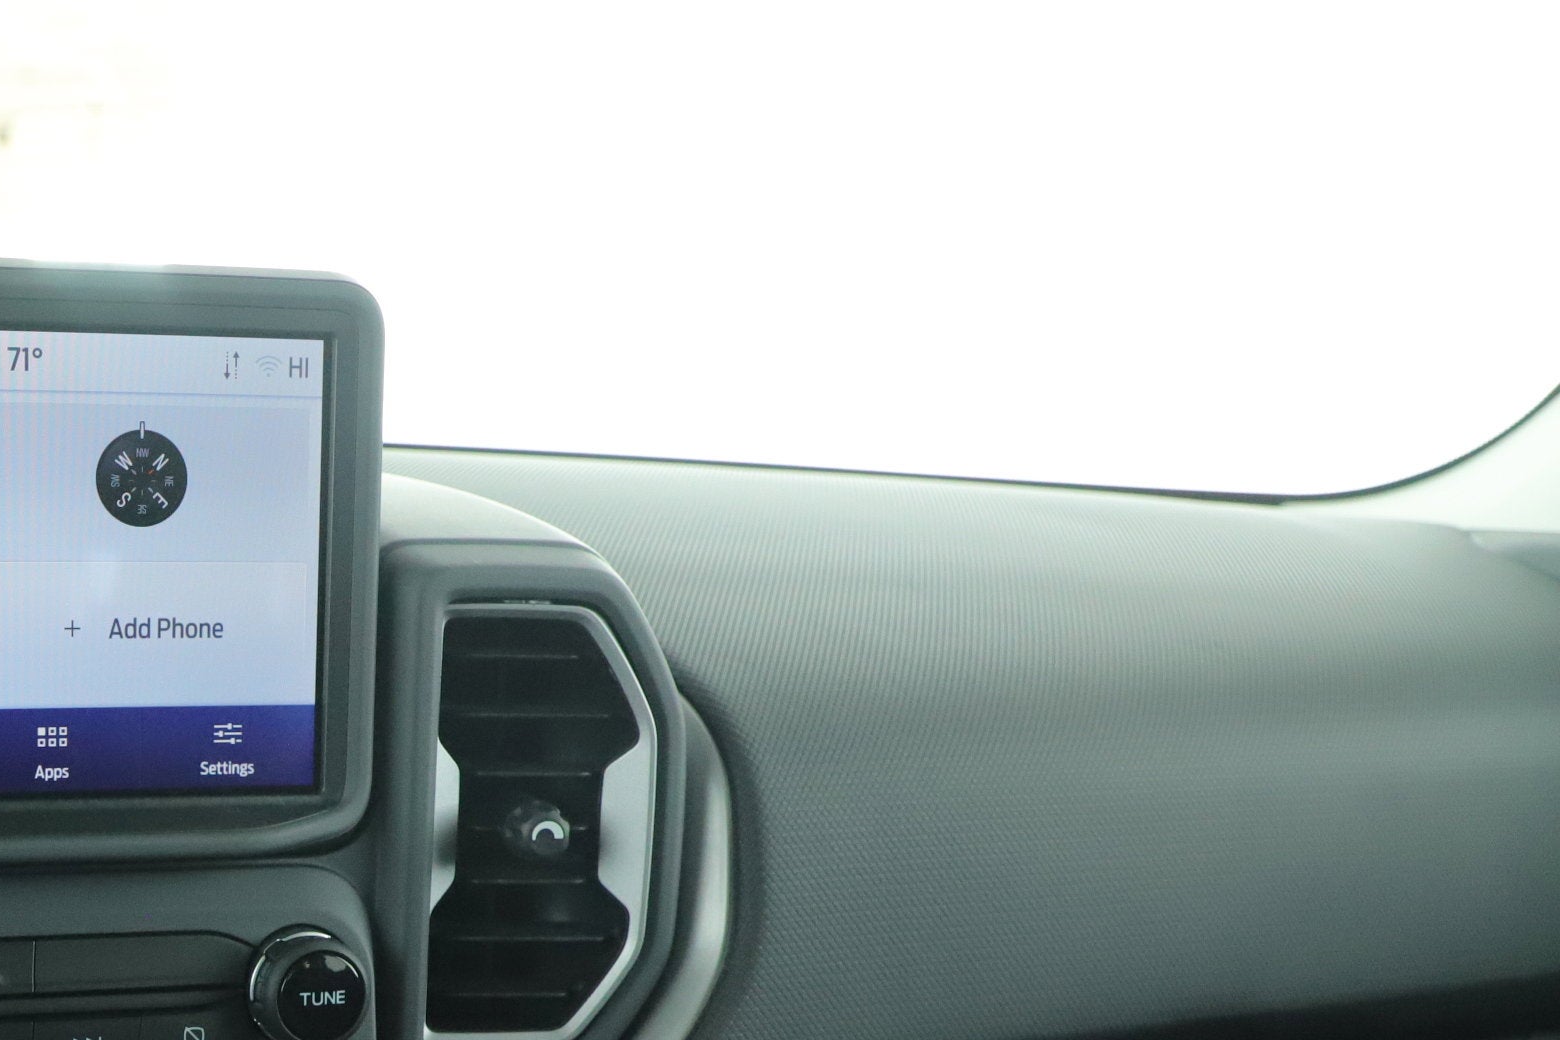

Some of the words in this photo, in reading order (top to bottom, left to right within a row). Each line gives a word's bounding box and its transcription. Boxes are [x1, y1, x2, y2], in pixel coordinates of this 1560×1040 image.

[7, 346, 43, 372] 71°
[288, 356, 309, 379] HI
[114, 450, 133, 471] W
[152, 453, 170, 472] N
[116, 491, 132, 508] S
[152, 491, 169, 509] E
[108, 616, 152, 640] Add
[156, 616, 225, 640] Phone
[34, 764, 70, 782] Apps
[199, 760, 255, 778] Settings
[298, 989, 347, 1007] TUNE
